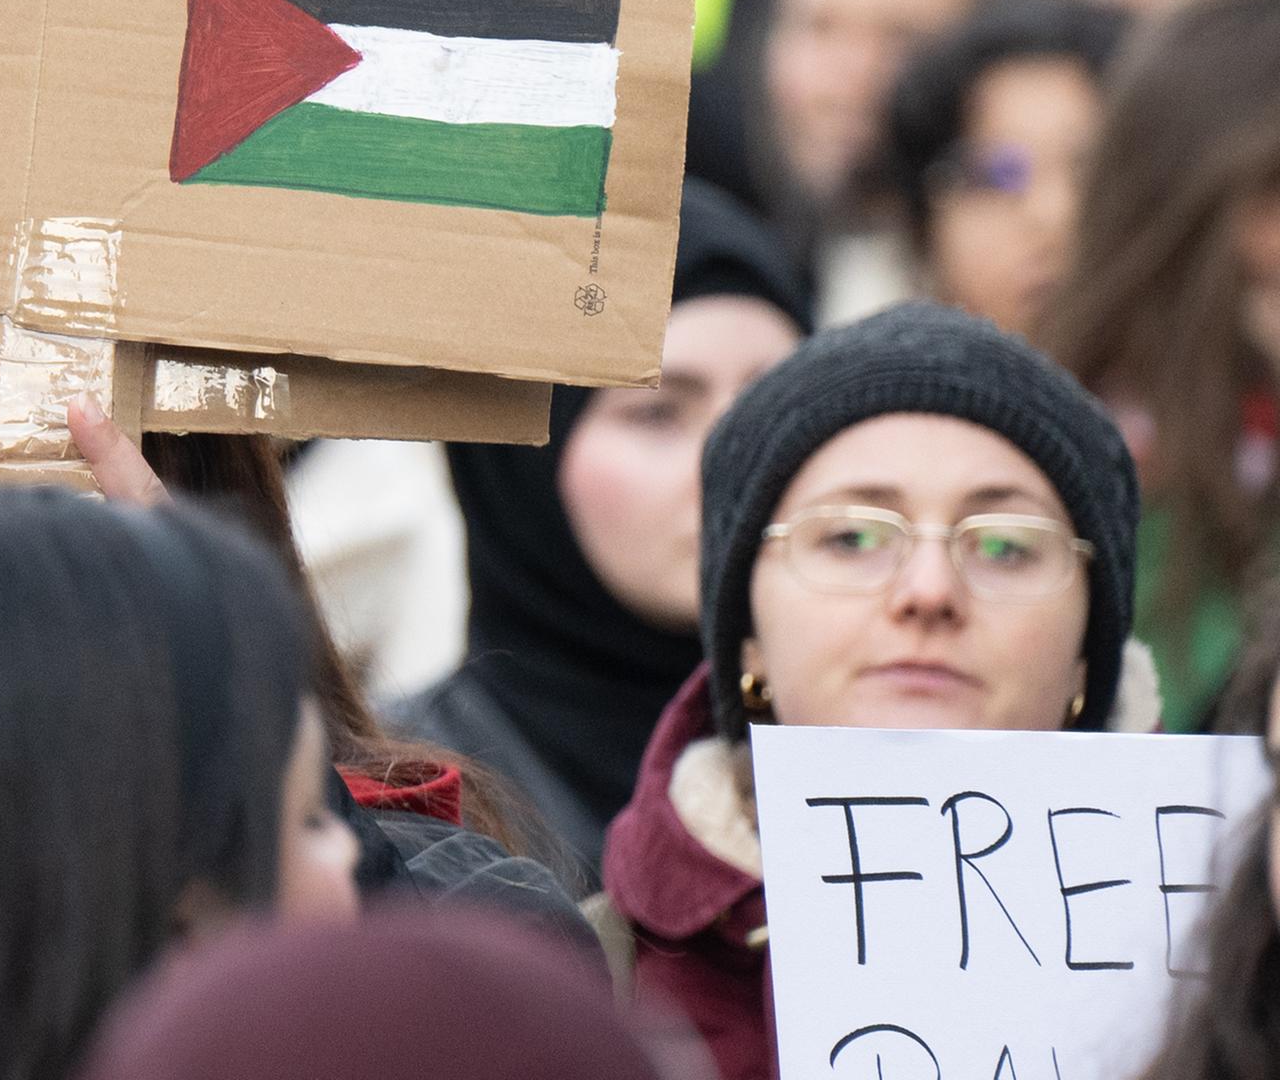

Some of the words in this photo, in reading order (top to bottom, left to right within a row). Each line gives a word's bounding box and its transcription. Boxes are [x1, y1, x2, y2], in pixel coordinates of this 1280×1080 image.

[591, 239, 600, 255] box
[589, 255, 598, 274] This
[805, 791, 1226, 979] FREE
